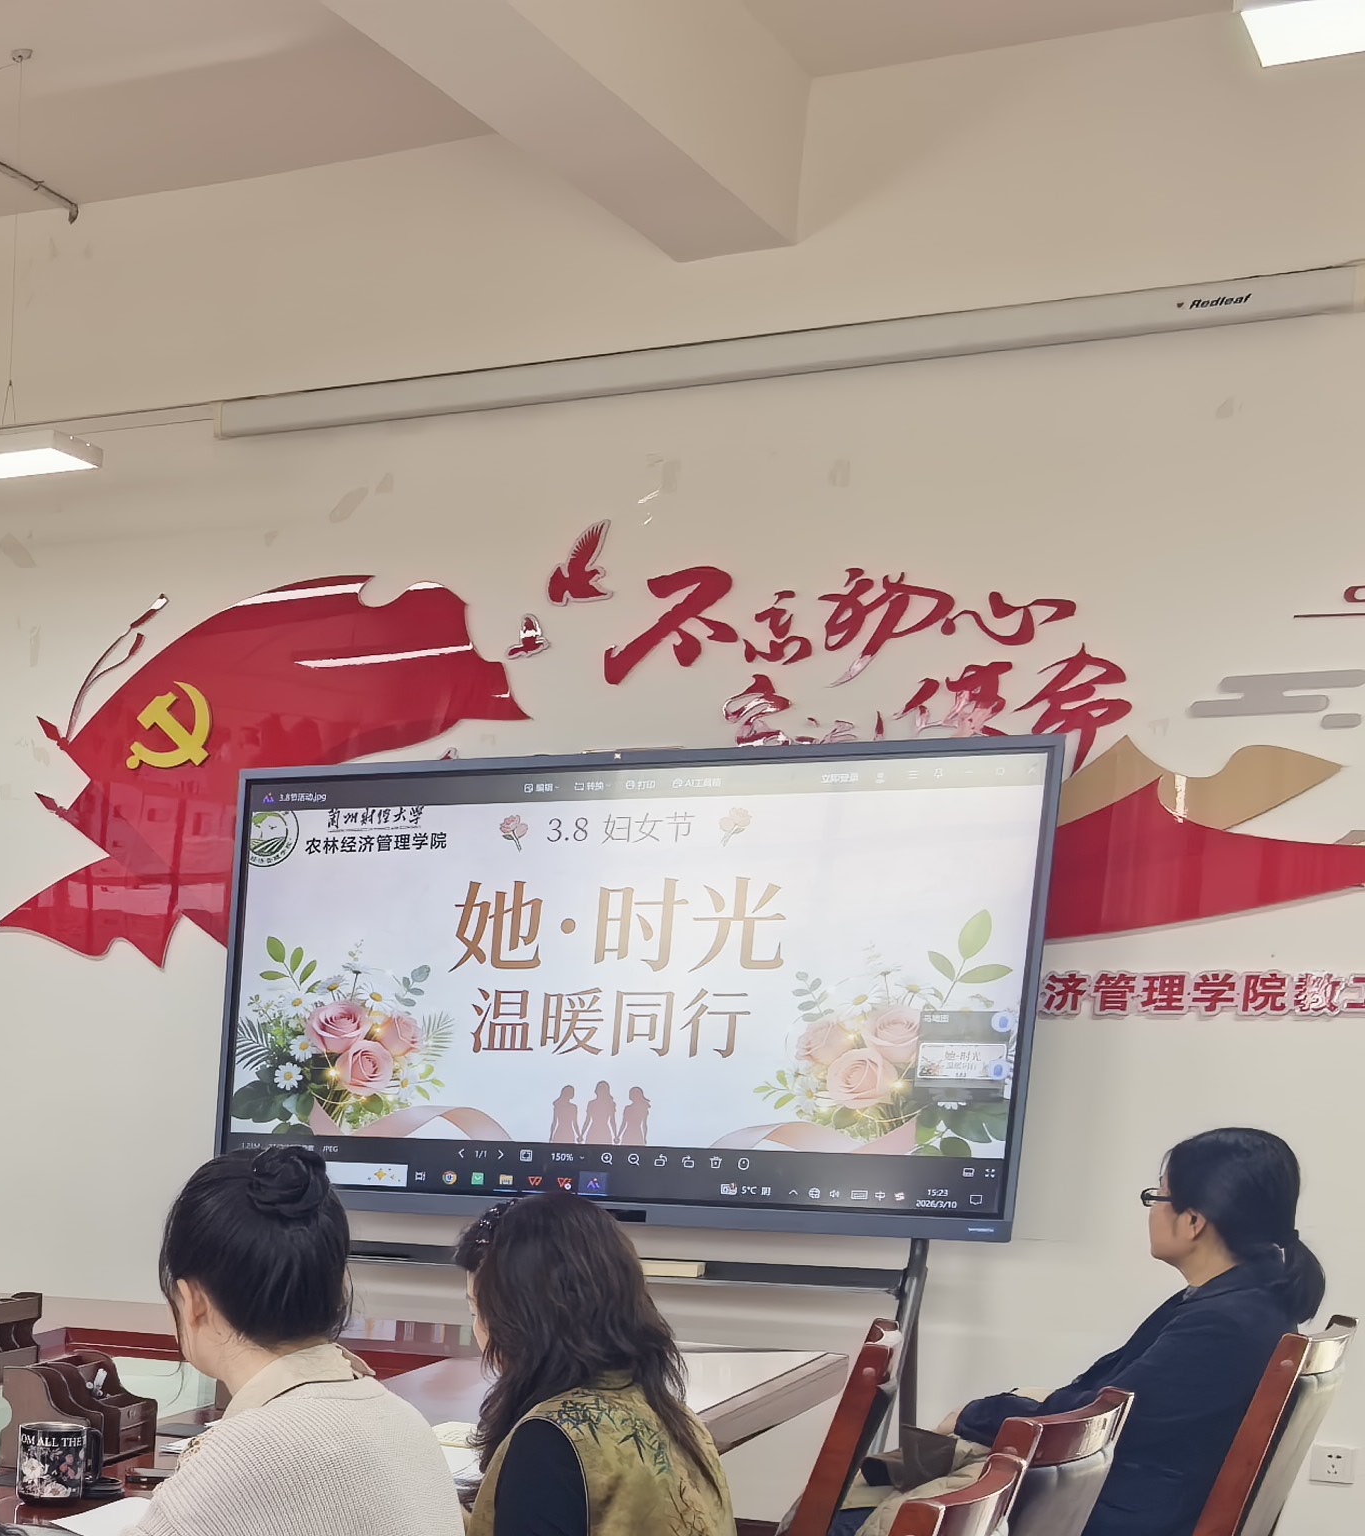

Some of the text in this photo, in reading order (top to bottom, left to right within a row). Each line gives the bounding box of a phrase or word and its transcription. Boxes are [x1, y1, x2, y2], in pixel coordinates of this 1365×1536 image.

[547, 811, 696, 844] 3.8 妇女节
[305, 832, 447, 855] 农林经济管理学院
[448, 876, 786, 973] 她·时光
[470, 987, 751, 1058] 温暖同行
[323, 1145, 339, 1153] JPEG
[551, 1152, 574, 1162] 150%
[927, 1188, 949, 1198] 15:23
[916, 1199, 957, 1209] 2026/3/10
[37, 1436, 59, 1447] ALL
